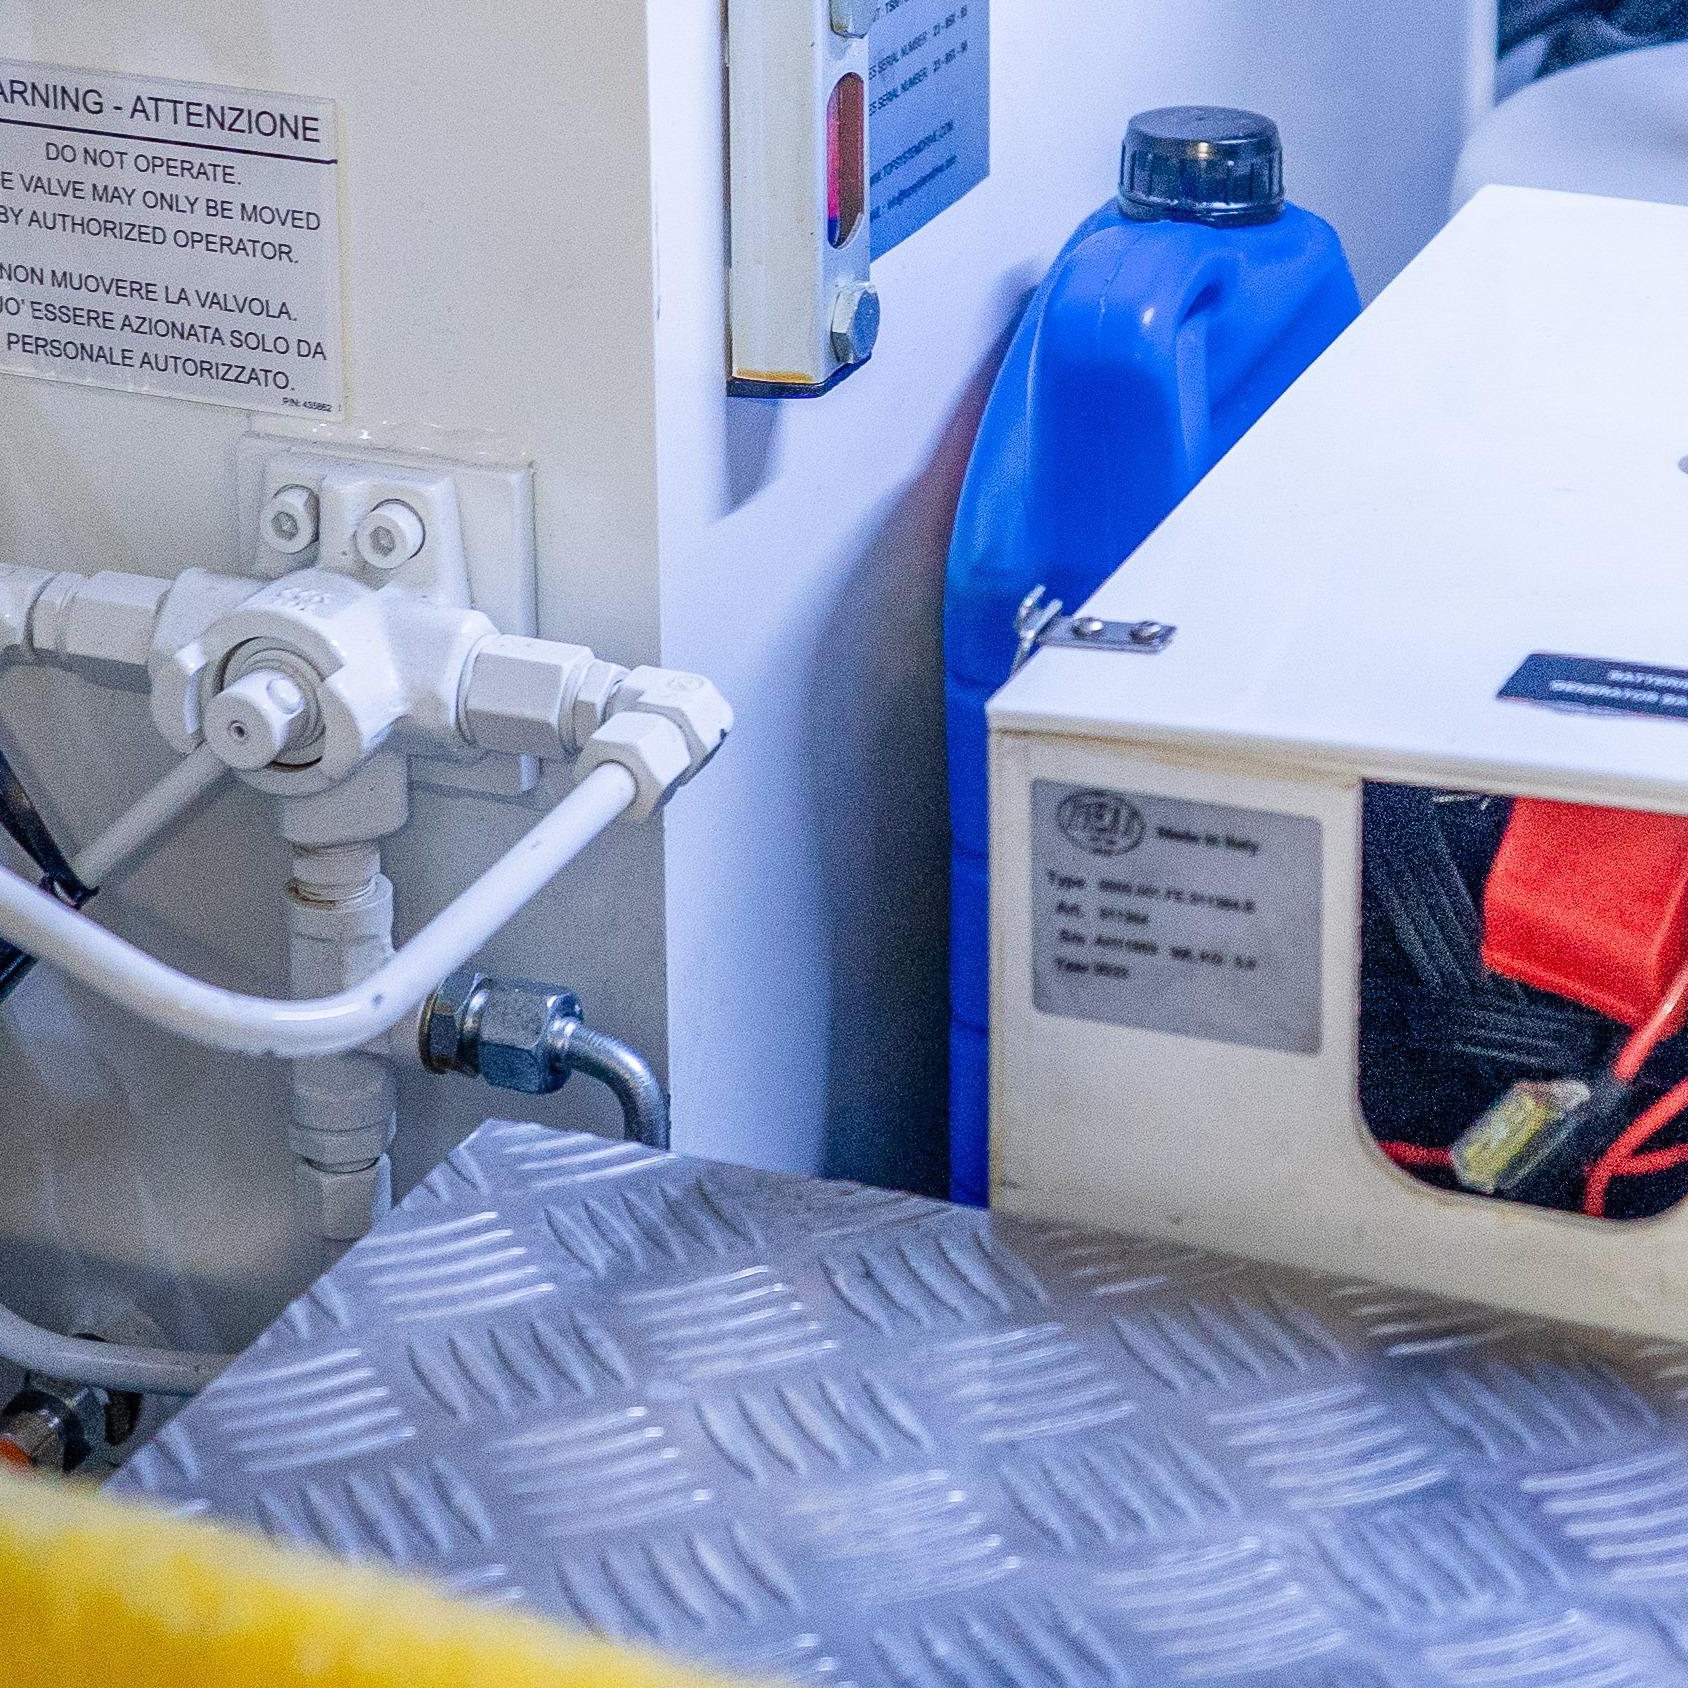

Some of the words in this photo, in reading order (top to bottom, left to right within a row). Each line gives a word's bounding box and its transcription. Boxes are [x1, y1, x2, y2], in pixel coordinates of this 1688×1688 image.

[878, 52, 899, 74] SERIAL
[900, 30, 927, 58] NUMBER
[878, 87, 899, 110] SERIAL
[900, 66, 928, 93] NUMBER
[129, 96, 321, 142] ATTENZIONE
[45, 143, 76, 163] DO
[84, 147, 128, 169] NOT
[134, 155, 242, 185] OPERATE.
[19, 173, 85, 200] VALVE
[91, 184, 136, 206] MAY
[142, 190, 199, 215] ONLY
[205, 198, 235, 219] BE
[240, 203, 321, 231] MOVED
[28, 209, 167, 245] AUTHORIZED
[173, 230, 299, 264] OPERATOR.
[51, 269, 158, 302] MUOVERE
[165, 285, 191, 306] LA
[195, 290, 298, 322] VALVOLA.
[30, 301, 115, 330] ESSERE
[120, 314, 225, 346] AZIONATA
[229, 330, 290, 356] SOLO
[296, 339, 327, 361] DA
[7, 333, 135, 367] PERSONALE
[139, 351, 295, 391] AUTORIZZATO.
